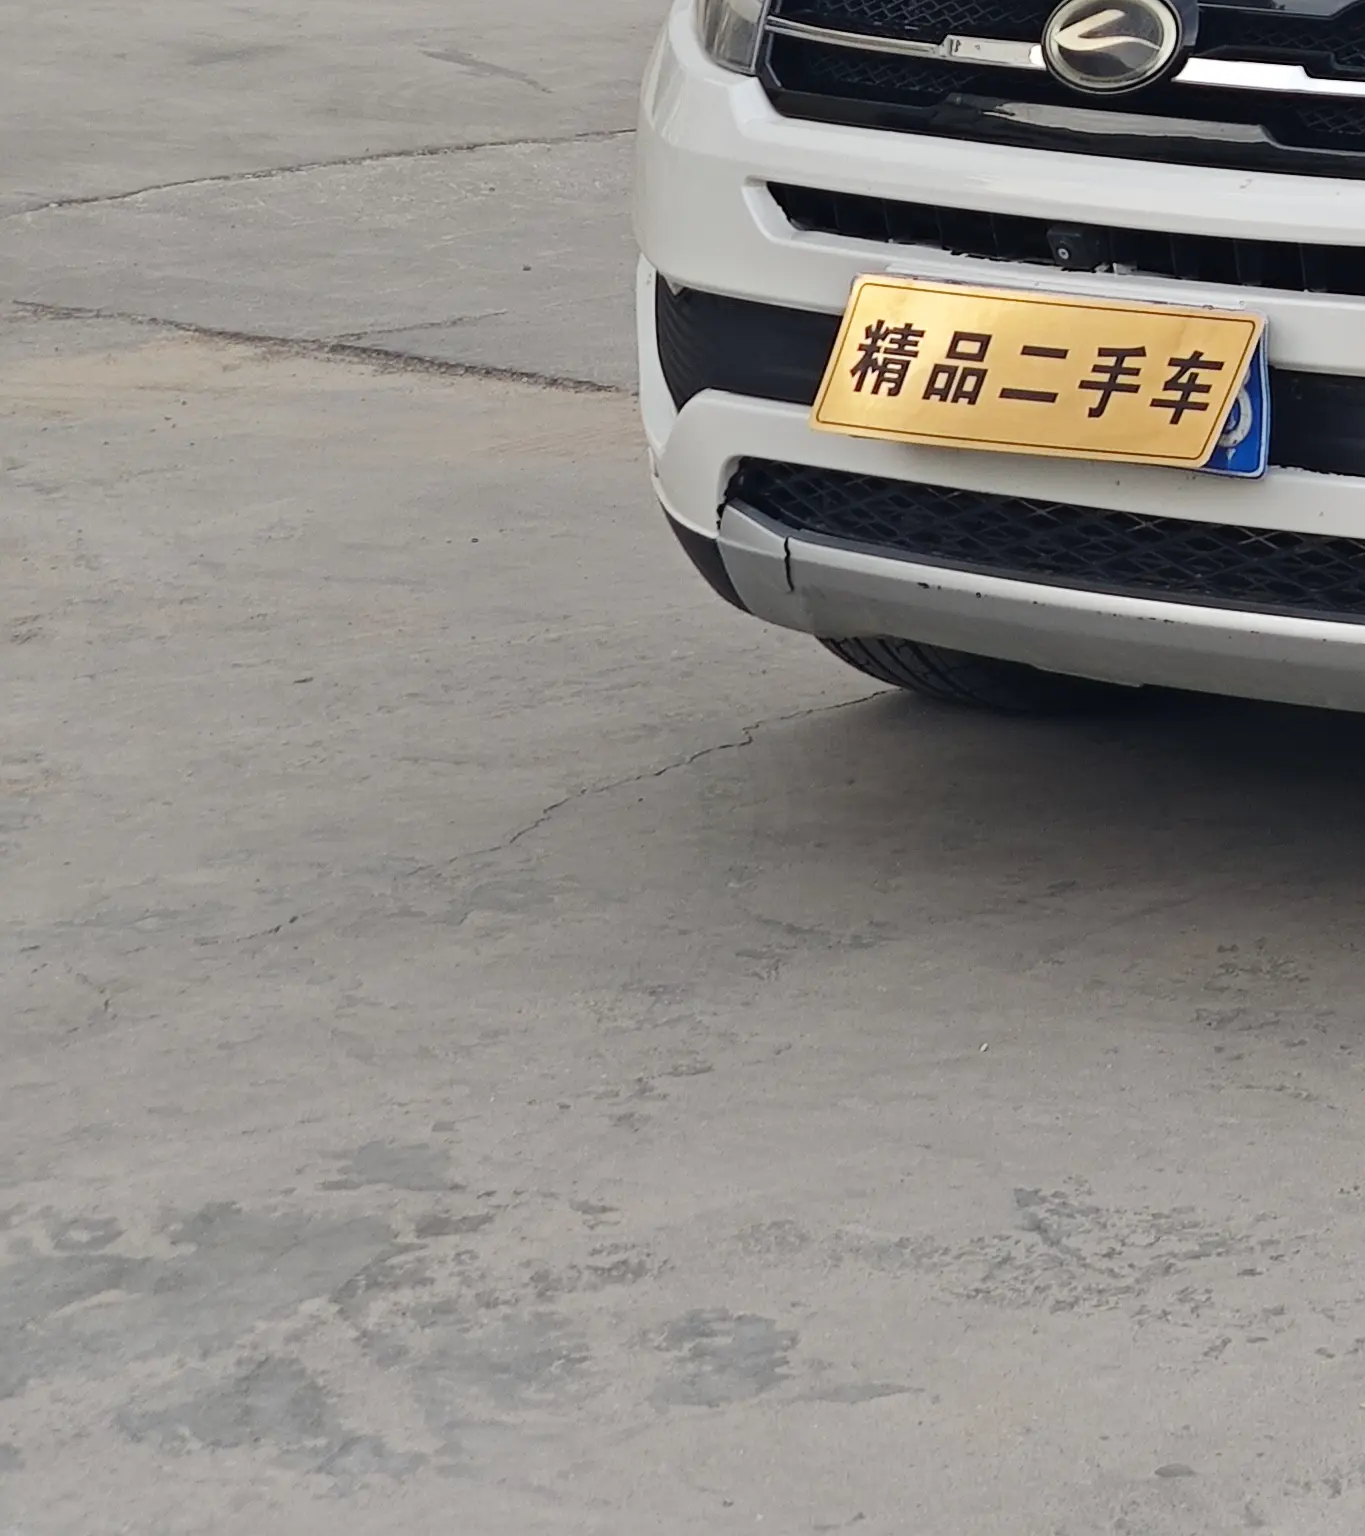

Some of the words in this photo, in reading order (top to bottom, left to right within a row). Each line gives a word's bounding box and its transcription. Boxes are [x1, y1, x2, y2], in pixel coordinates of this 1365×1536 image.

[850, 319, 1225, 426] 精品二手车
